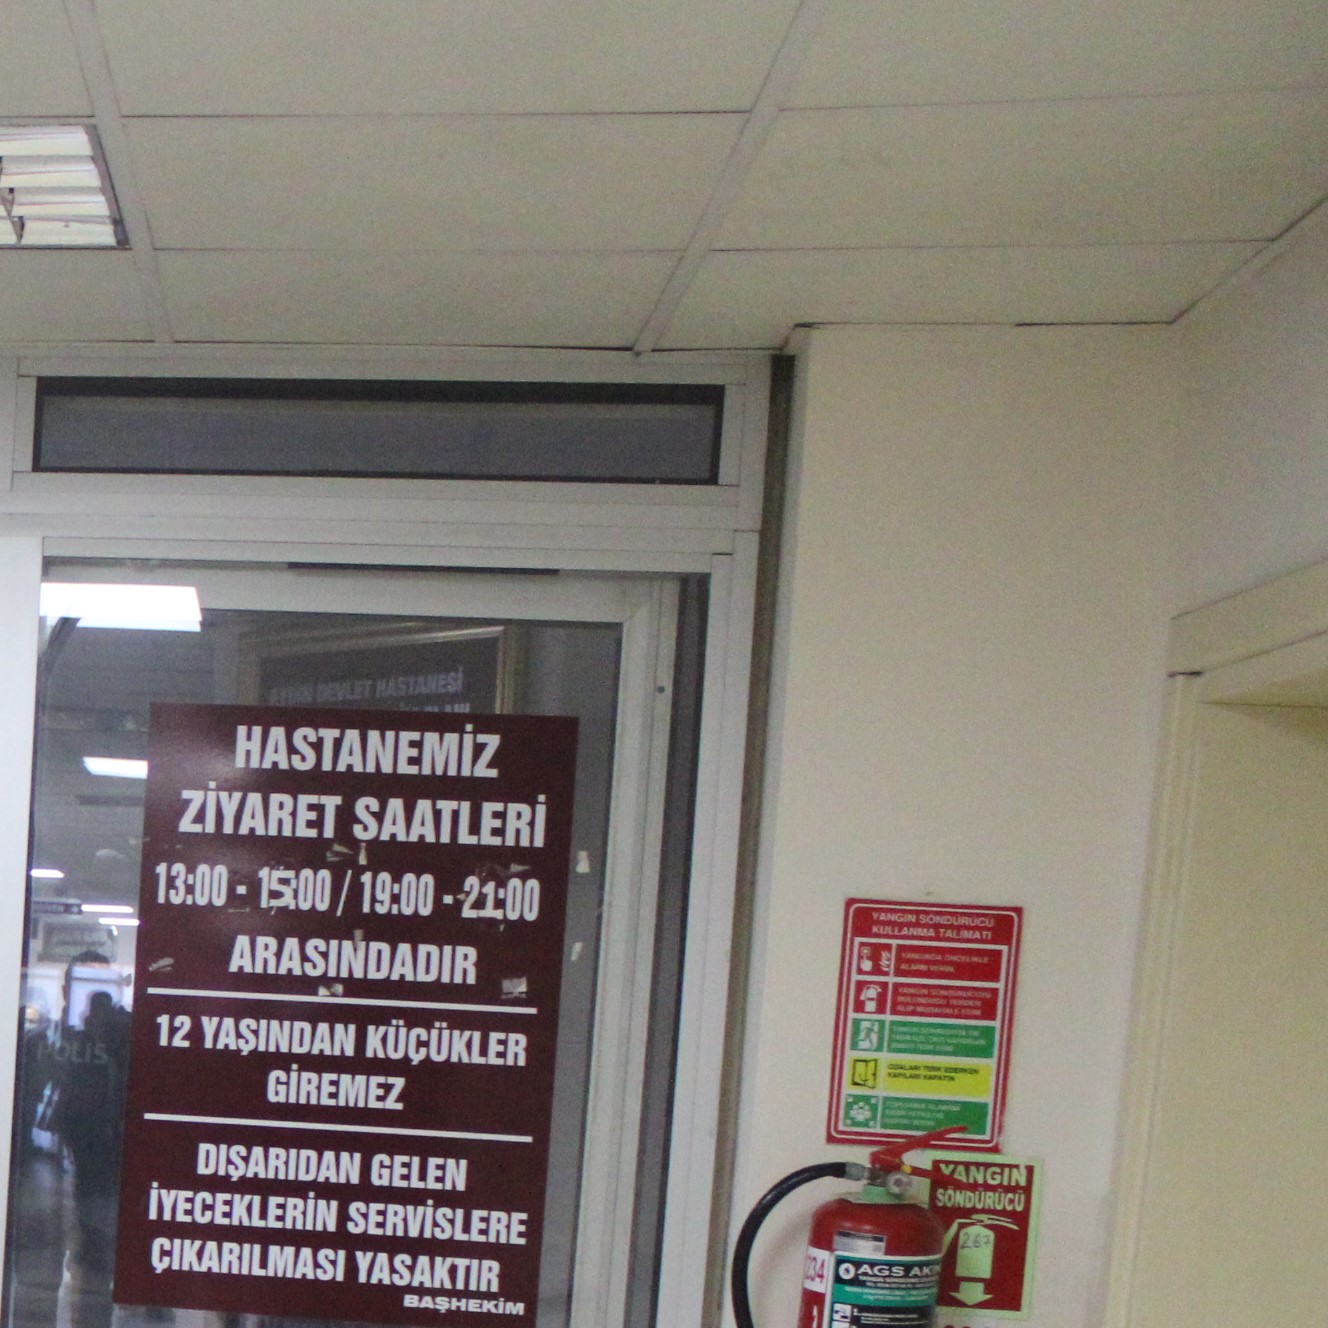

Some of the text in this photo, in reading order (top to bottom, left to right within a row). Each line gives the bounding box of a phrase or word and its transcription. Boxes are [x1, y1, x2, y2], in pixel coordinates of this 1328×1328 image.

[235, 723, 501, 778] HASTANEMİZ
[178, 781, 547, 848] ZİYARET SAATLERİ
[155, 862, 228, 907] 13:00
[360, 871, 435, 916] 19:00
[871, 912, 916, 923] YANGIN
[871, 925, 936, 937] KULLANMA
[228, 935, 478, 985] ARASINDADIR
[156, 1015, 527, 1066] 12 YAŞINDAN KÜÇÜKLER
[267, 1063, 406, 1110] GİREMEZ
[197, 1142, 468, 1192] DIŞARIDAN GELEN
[148, 1182, 528, 1246] İYECEKLERİN SERVİSLERE
[936, 1185, 1025, 1211] SÖNDÜRÜCÜ
[151, 1236, 501, 1293] ÇIKARILMASI YASAKTIR
[857, 1264, 905, 1277] AGS
[403, 1294, 526, 1316] BAŞHEKİM
